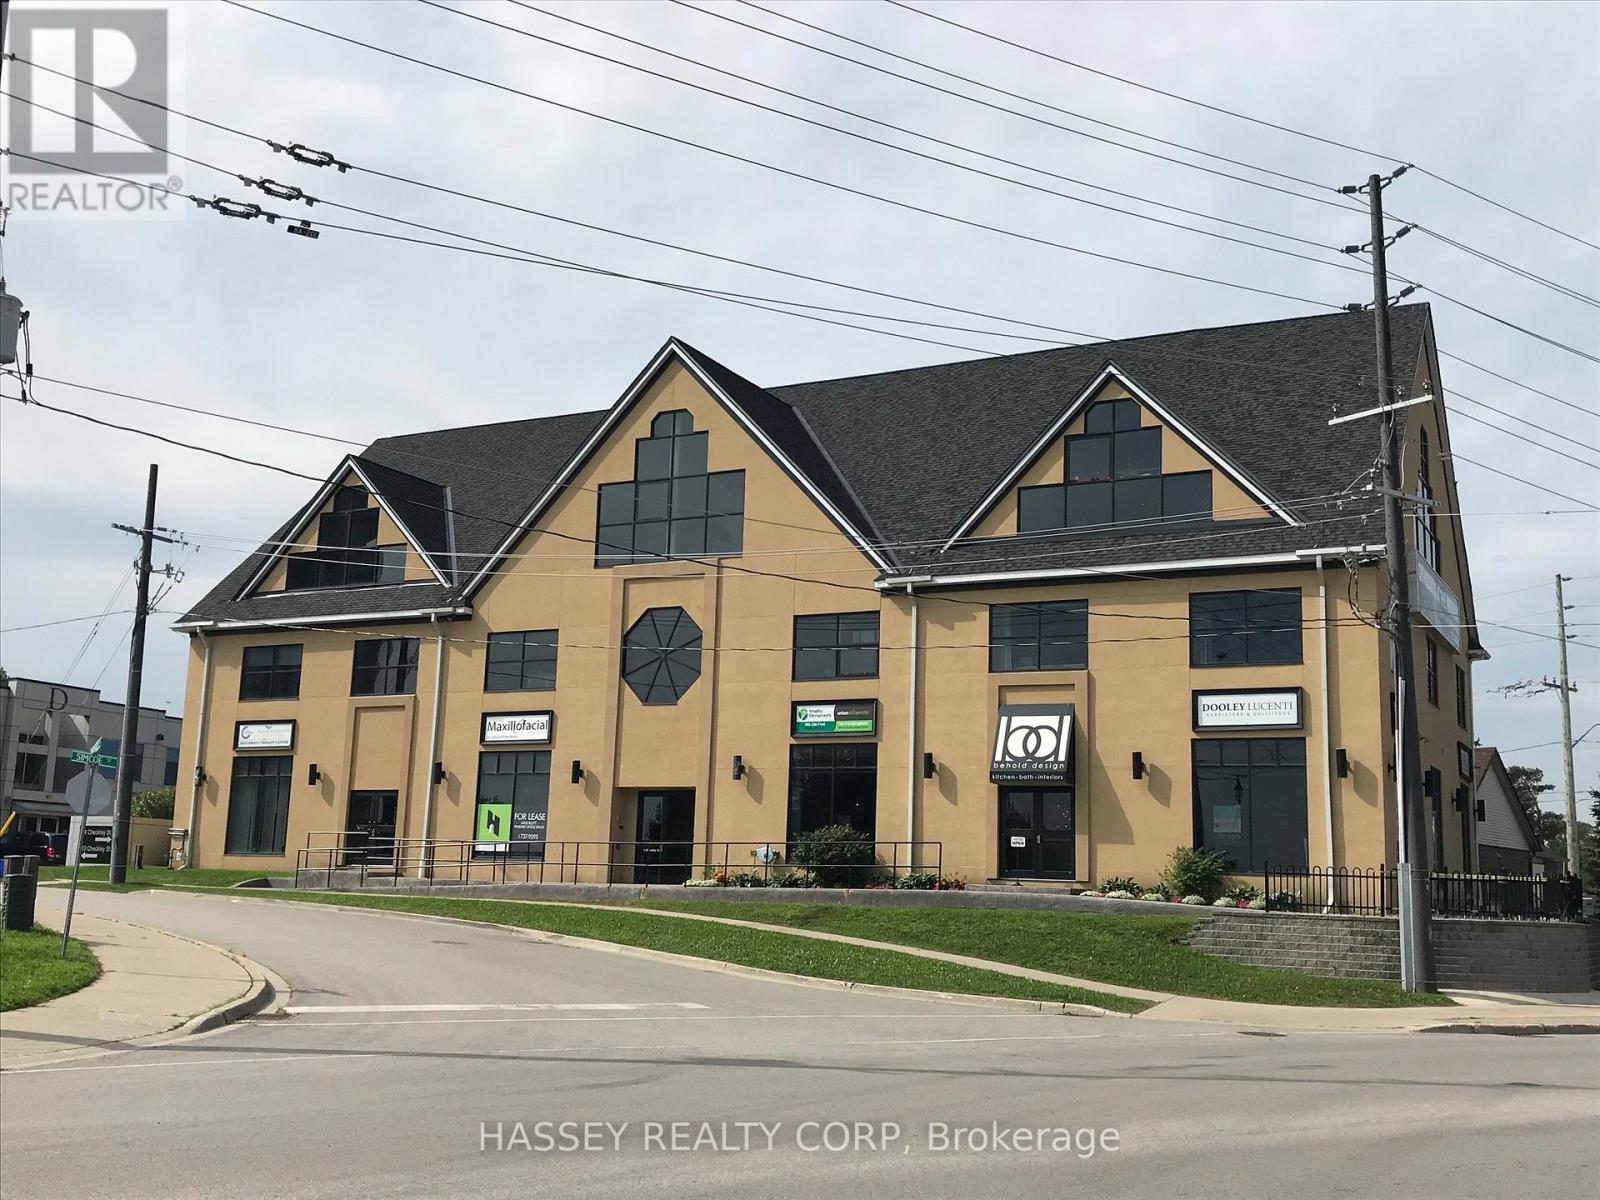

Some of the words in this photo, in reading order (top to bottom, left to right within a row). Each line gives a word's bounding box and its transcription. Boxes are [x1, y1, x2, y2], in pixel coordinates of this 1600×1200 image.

[1202, 703, 1246, 712] DOOLEY
[1247, 701, 1293, 711] LUCENTI
[487, 719, 549, 732] Maxillofacial
[76, 752, 103, 764] SIMCOE
[1032, 762, 1065, 770] design
[514, 812, 527, 821] FOR
[527, 812, 546, 821] LEASE
